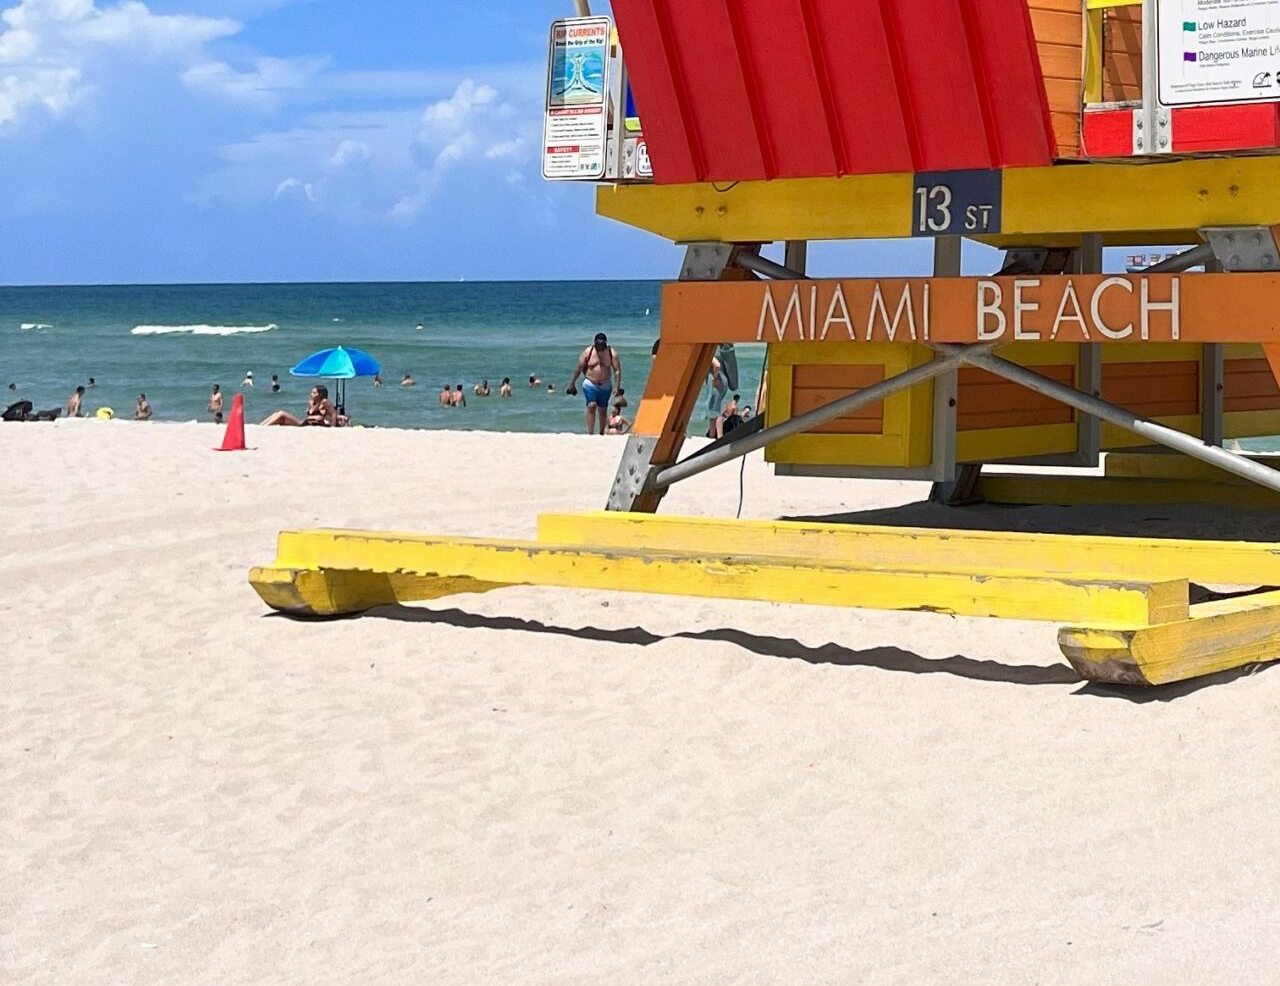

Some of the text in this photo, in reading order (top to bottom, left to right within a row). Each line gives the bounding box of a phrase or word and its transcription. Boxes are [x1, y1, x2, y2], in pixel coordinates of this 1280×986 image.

[1198, 17, 1247, 31] Low Hazard
[569, 26, 605, 38] CURRENTS
[1198, 50, 1240, 63] Dangerous
[916, 185, 993, 231] 13 ST
[757, 277, 1180, 341] MIAMI BEACH
